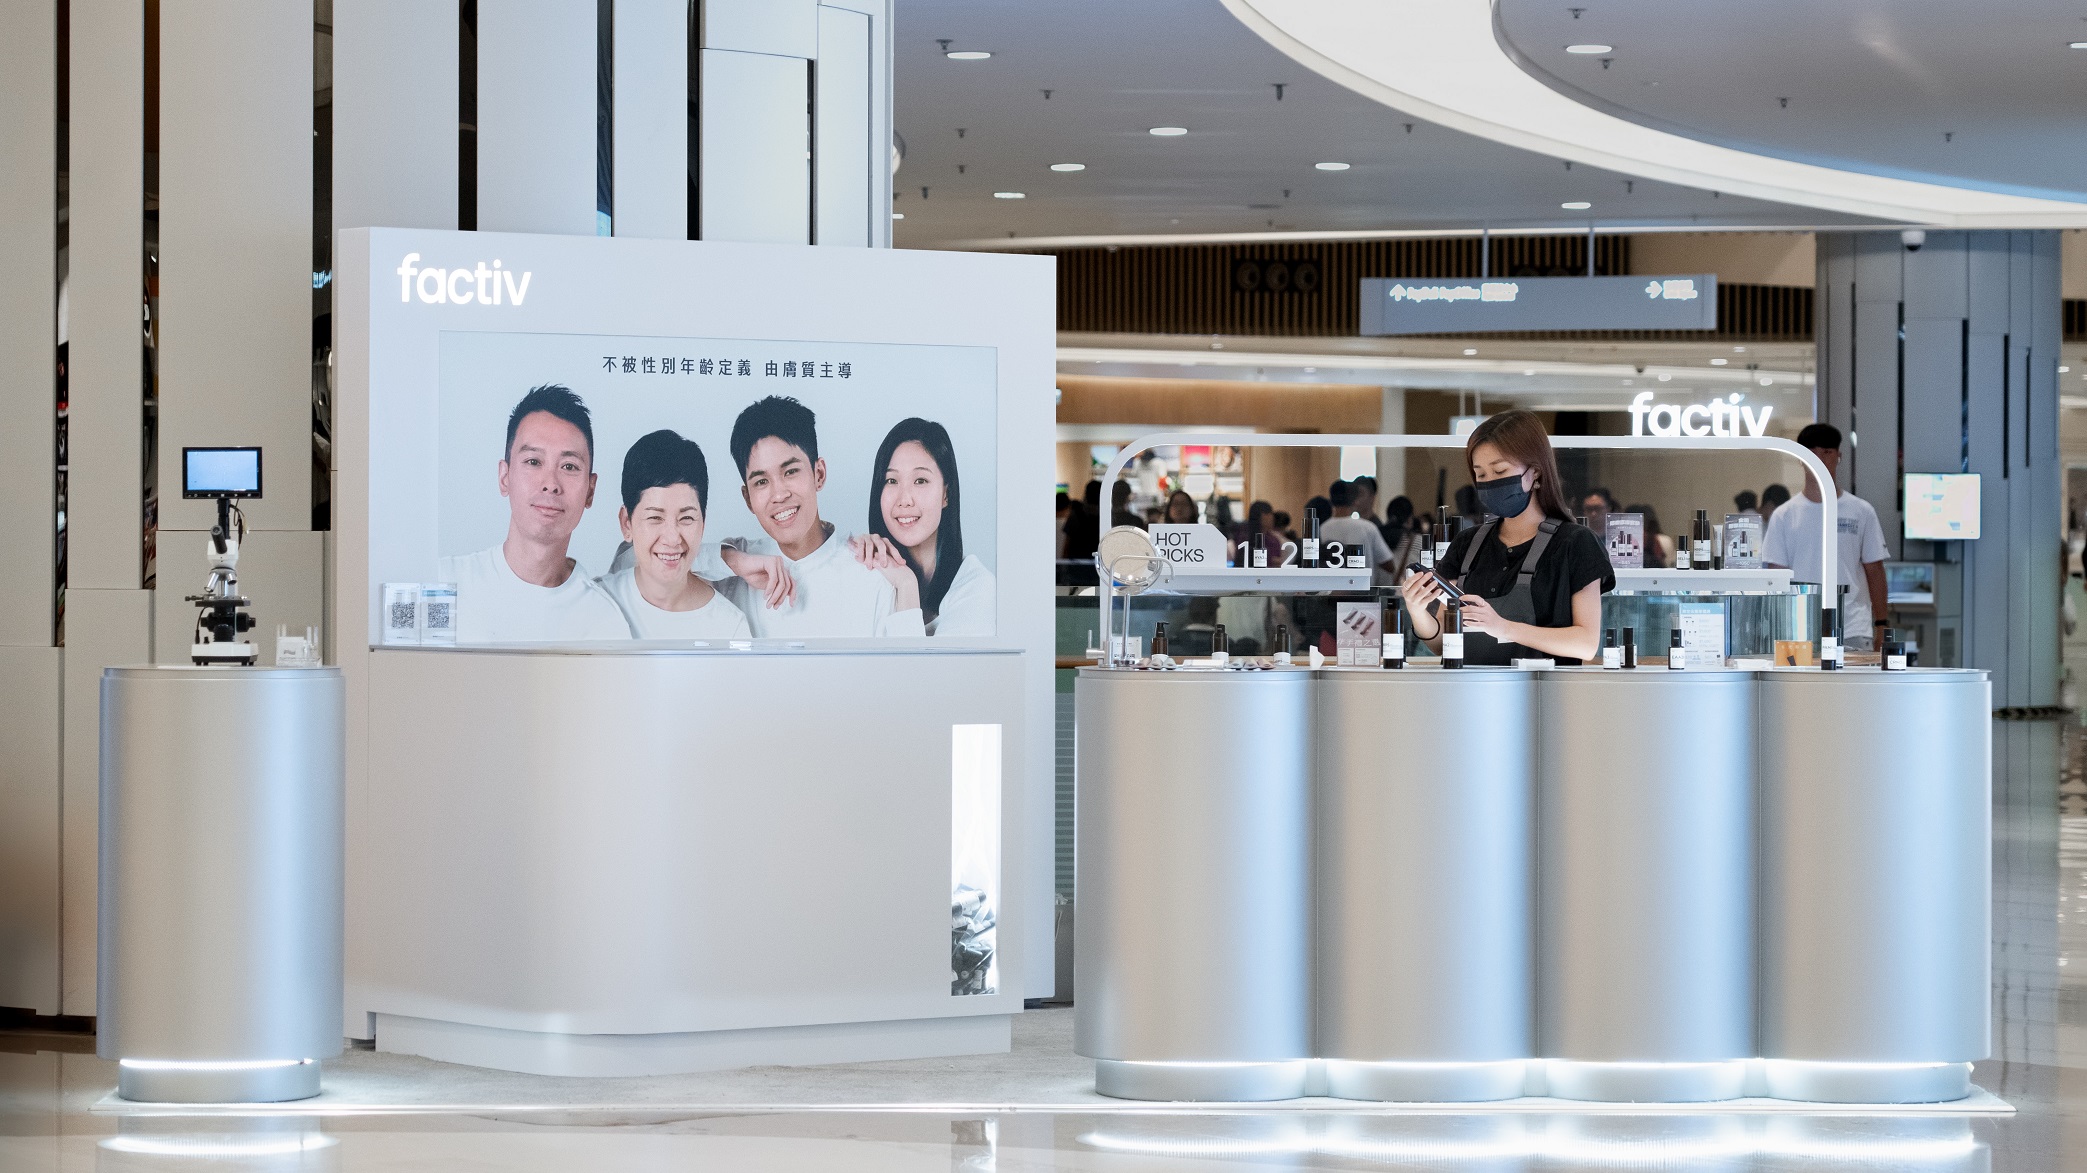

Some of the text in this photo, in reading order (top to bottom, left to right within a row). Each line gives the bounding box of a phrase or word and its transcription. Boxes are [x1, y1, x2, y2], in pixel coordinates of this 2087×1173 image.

[397, 252, 532, 306] factiv
[602, 356, 853, 379] 不被性別年齡定義 由膚質主導
[1628, 392, 1774, 437] factiv
[1156, 532, 1191, 546] HOT
[1237, 541, 1345, 568] 1 2 3
